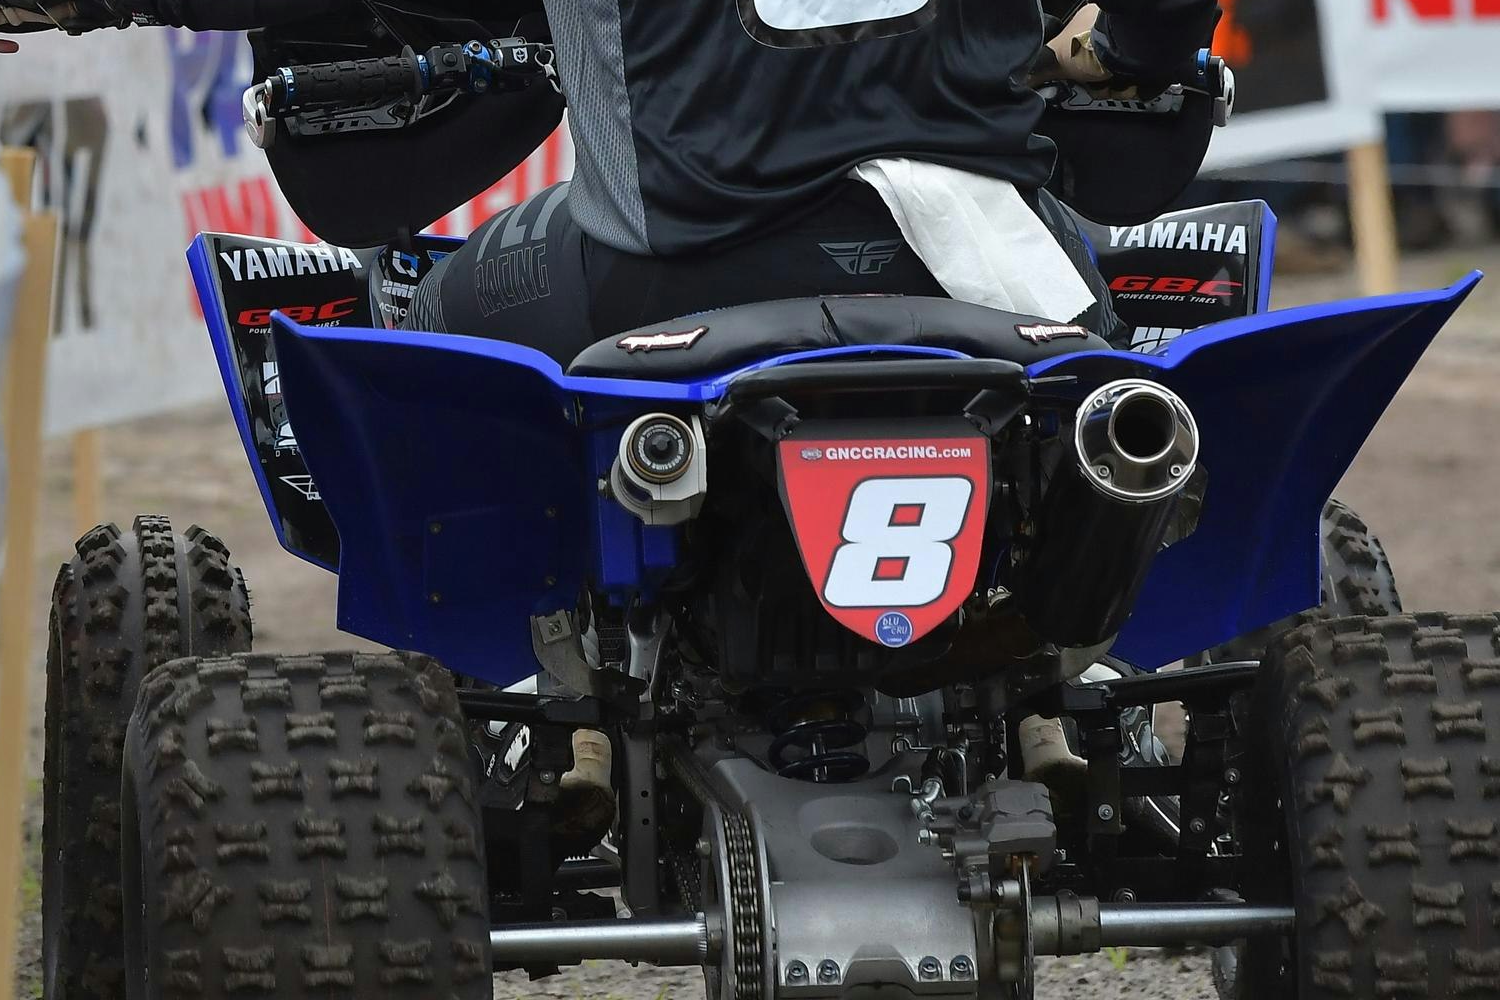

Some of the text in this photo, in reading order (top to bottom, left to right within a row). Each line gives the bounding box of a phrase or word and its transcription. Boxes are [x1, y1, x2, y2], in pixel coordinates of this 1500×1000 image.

[1108, 221, 1247, 255] YAMAHA
[219, 245, 363, 282] YAMAHA
[474, 243, 551, 318] RACING
[1108, 275, 1244, 297] GBC
[237, 297, 358, 326] GBC
[1116, 292, 1218, 304] POWERSPORTS TIRES
[825, 446, 972, 460] GNCCRACING.COM
[823, 475, 974, 609] 8
